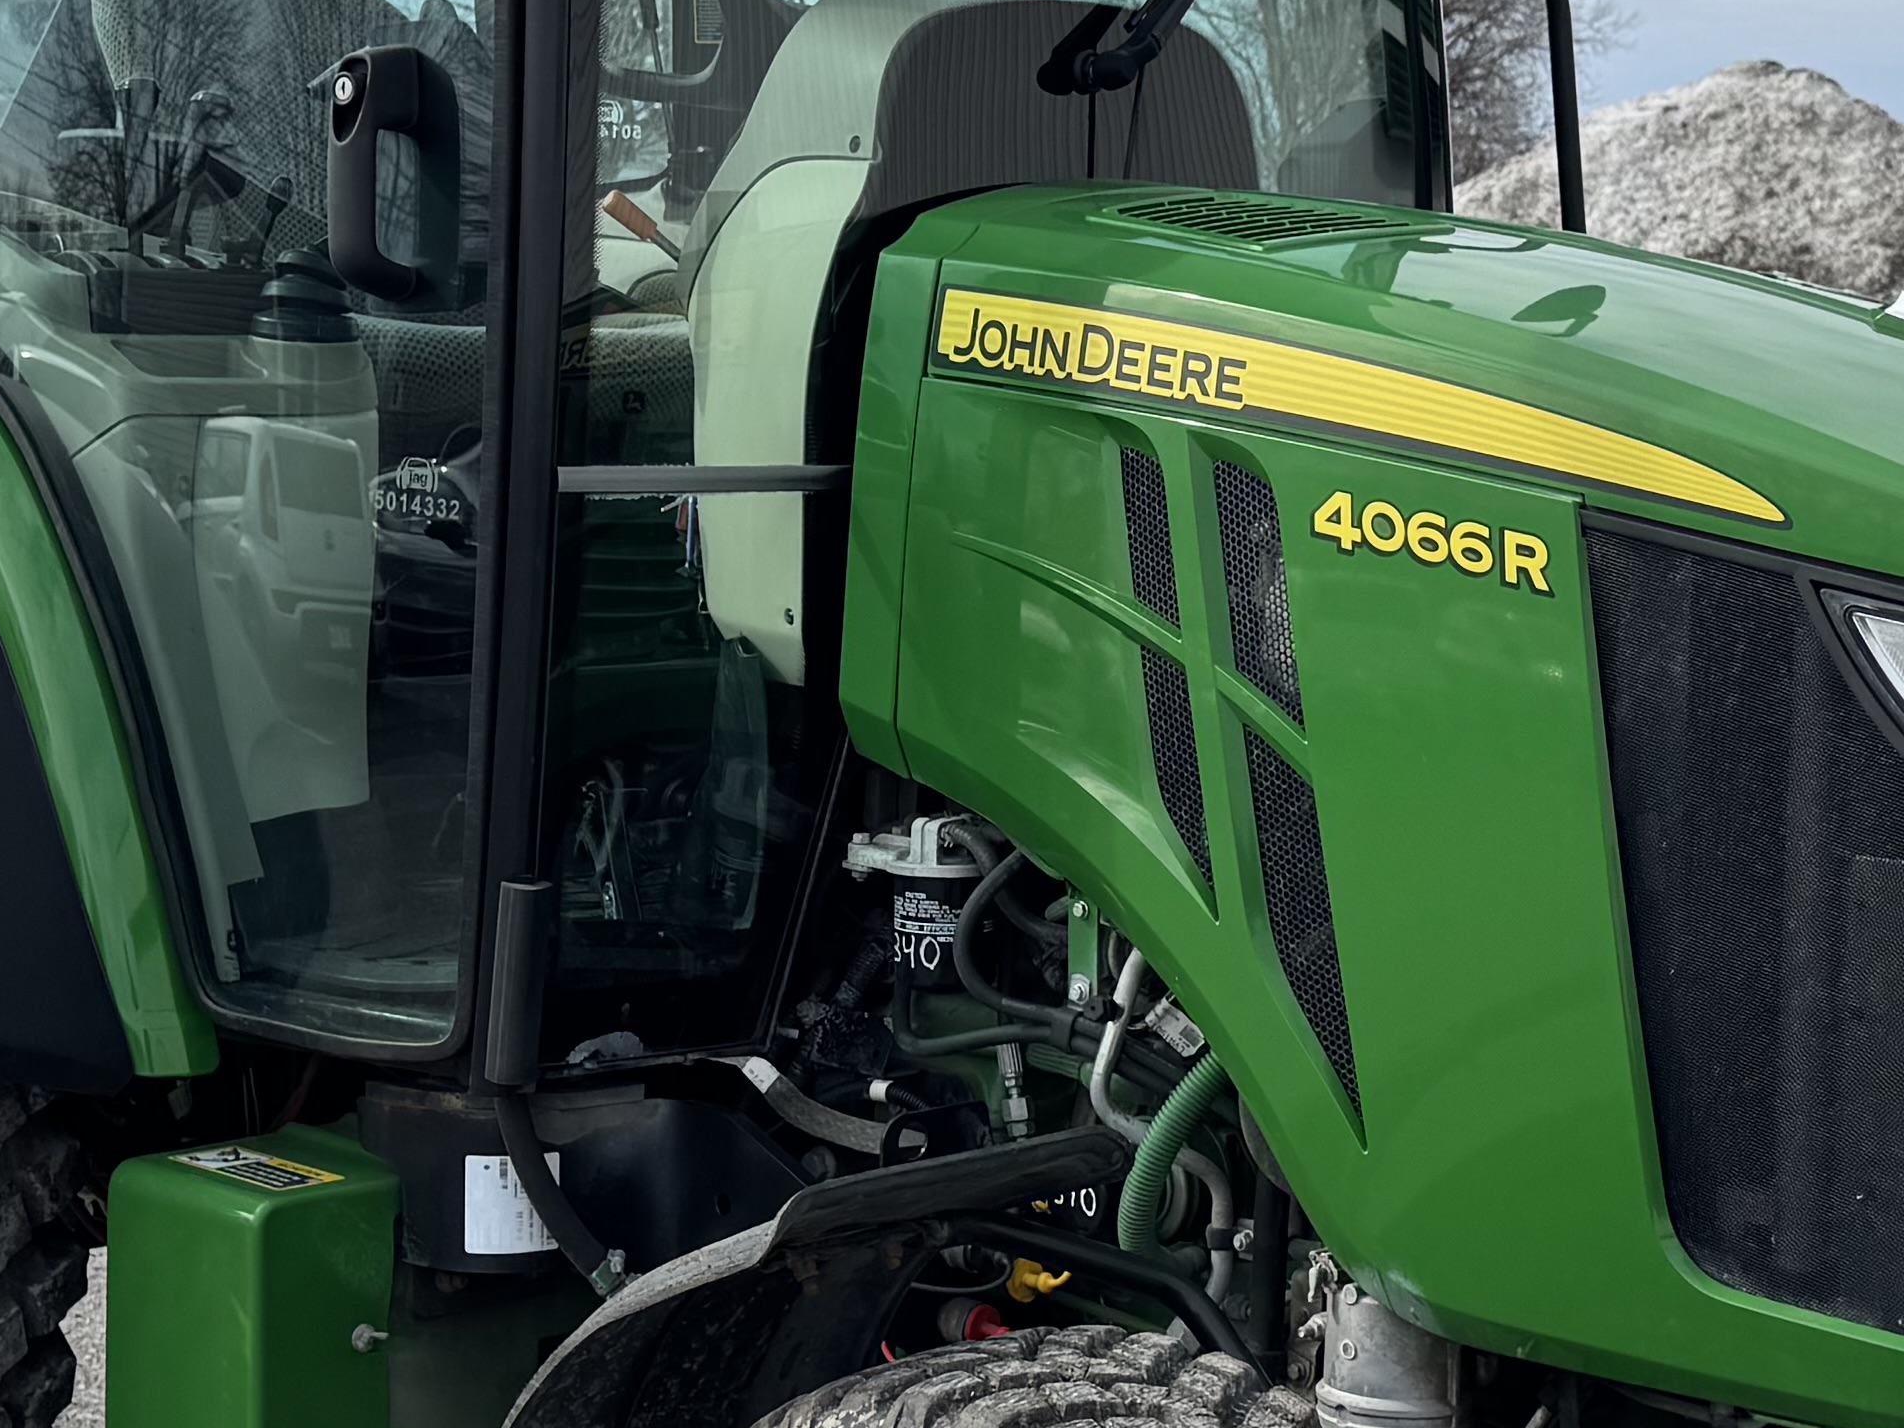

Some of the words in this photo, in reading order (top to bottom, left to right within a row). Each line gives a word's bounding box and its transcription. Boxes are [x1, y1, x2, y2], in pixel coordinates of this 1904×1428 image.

[952, 308, 1070, 373] JOHN
[1080, 324, 1248, 404] DEERE
[407, 470, 428, 487] Tag
[374, 489, 460, 520] 5014332
